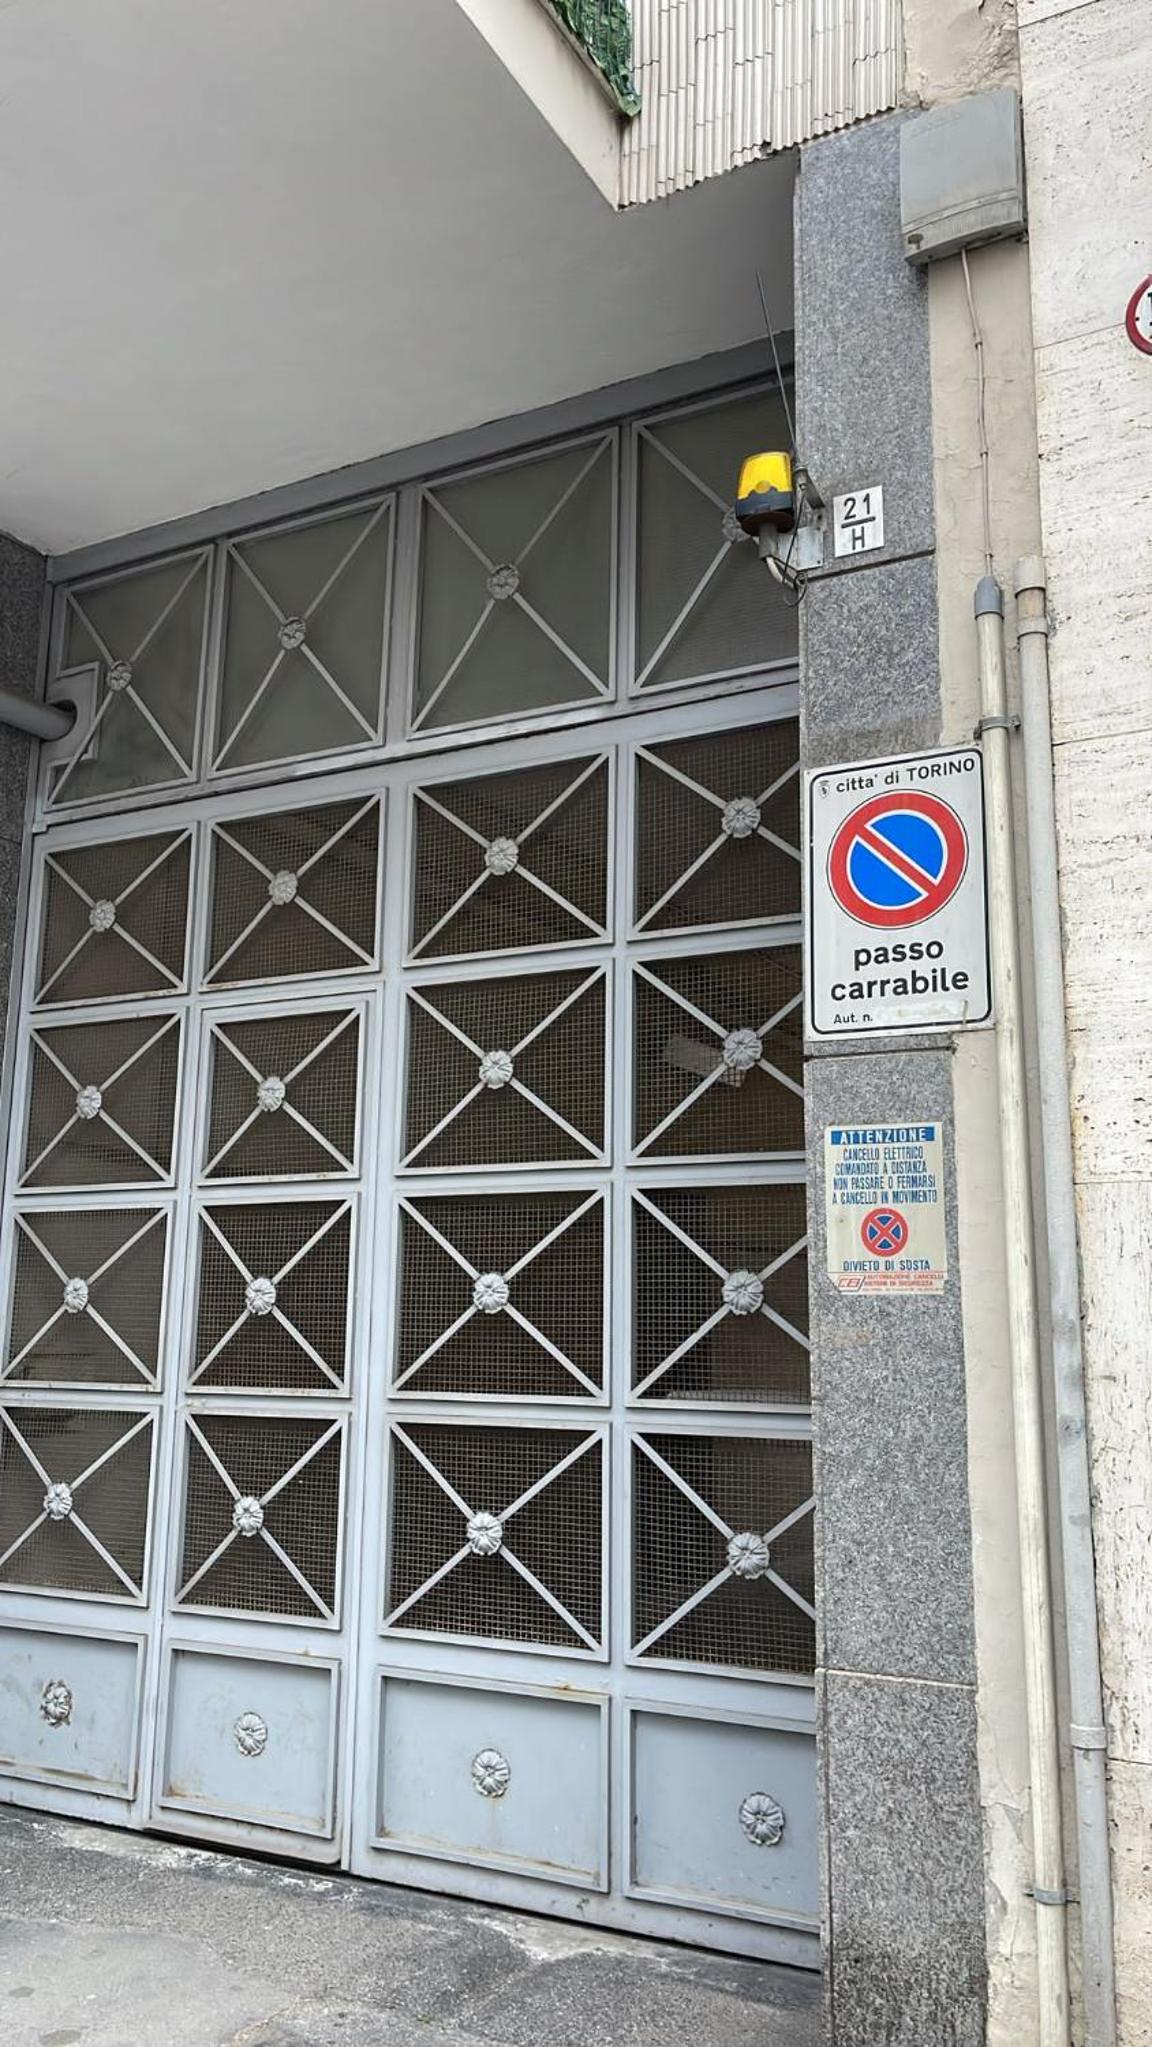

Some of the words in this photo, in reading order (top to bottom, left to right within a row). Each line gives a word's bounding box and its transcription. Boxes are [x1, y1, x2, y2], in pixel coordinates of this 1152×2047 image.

[843, 493, 871, 520] 21
[852, 526, 865, 551] H
[884, 771, 899, 786] di
[906, 758, 975, 781] TORINO
[854, 940, 944, 971] passo
[831, 967, 969, 1001] carrabile
[833, 1013, 858, 1024] Aut.
[863, 1013, 873, 1022] n.
[840, 1127, 927, 1145] ATTENZIONE
[843, 1147, 880, 1161] CANCELLO
[884, 1146, 924, 1160] ELETTRICO
[835, 1162, 880, 1175] COMANDATO
[883, 1162, 888, 1174] A
[891, 1160, 927, 1174] DISTANZA
[833, 1177, 848, 1190] NON
[851, 1176, 884, 1190] PASSARE
[888, 1176, 893, 1189] O
[897, 1175, 936, 1189] FERMARSI
[832, 1193, 837, 1205] A
[841, 1191, 878, 1205] CANCELLO
[881, 1191, 889, 1204] IN
[892, 1189, 937, 1204] MOVIMENTO
[843, 1260, 880, 1271] DIVIETO
[885, 1260, 895, 1271] DI
[900, 1259, 931, 1271] SOSTA
